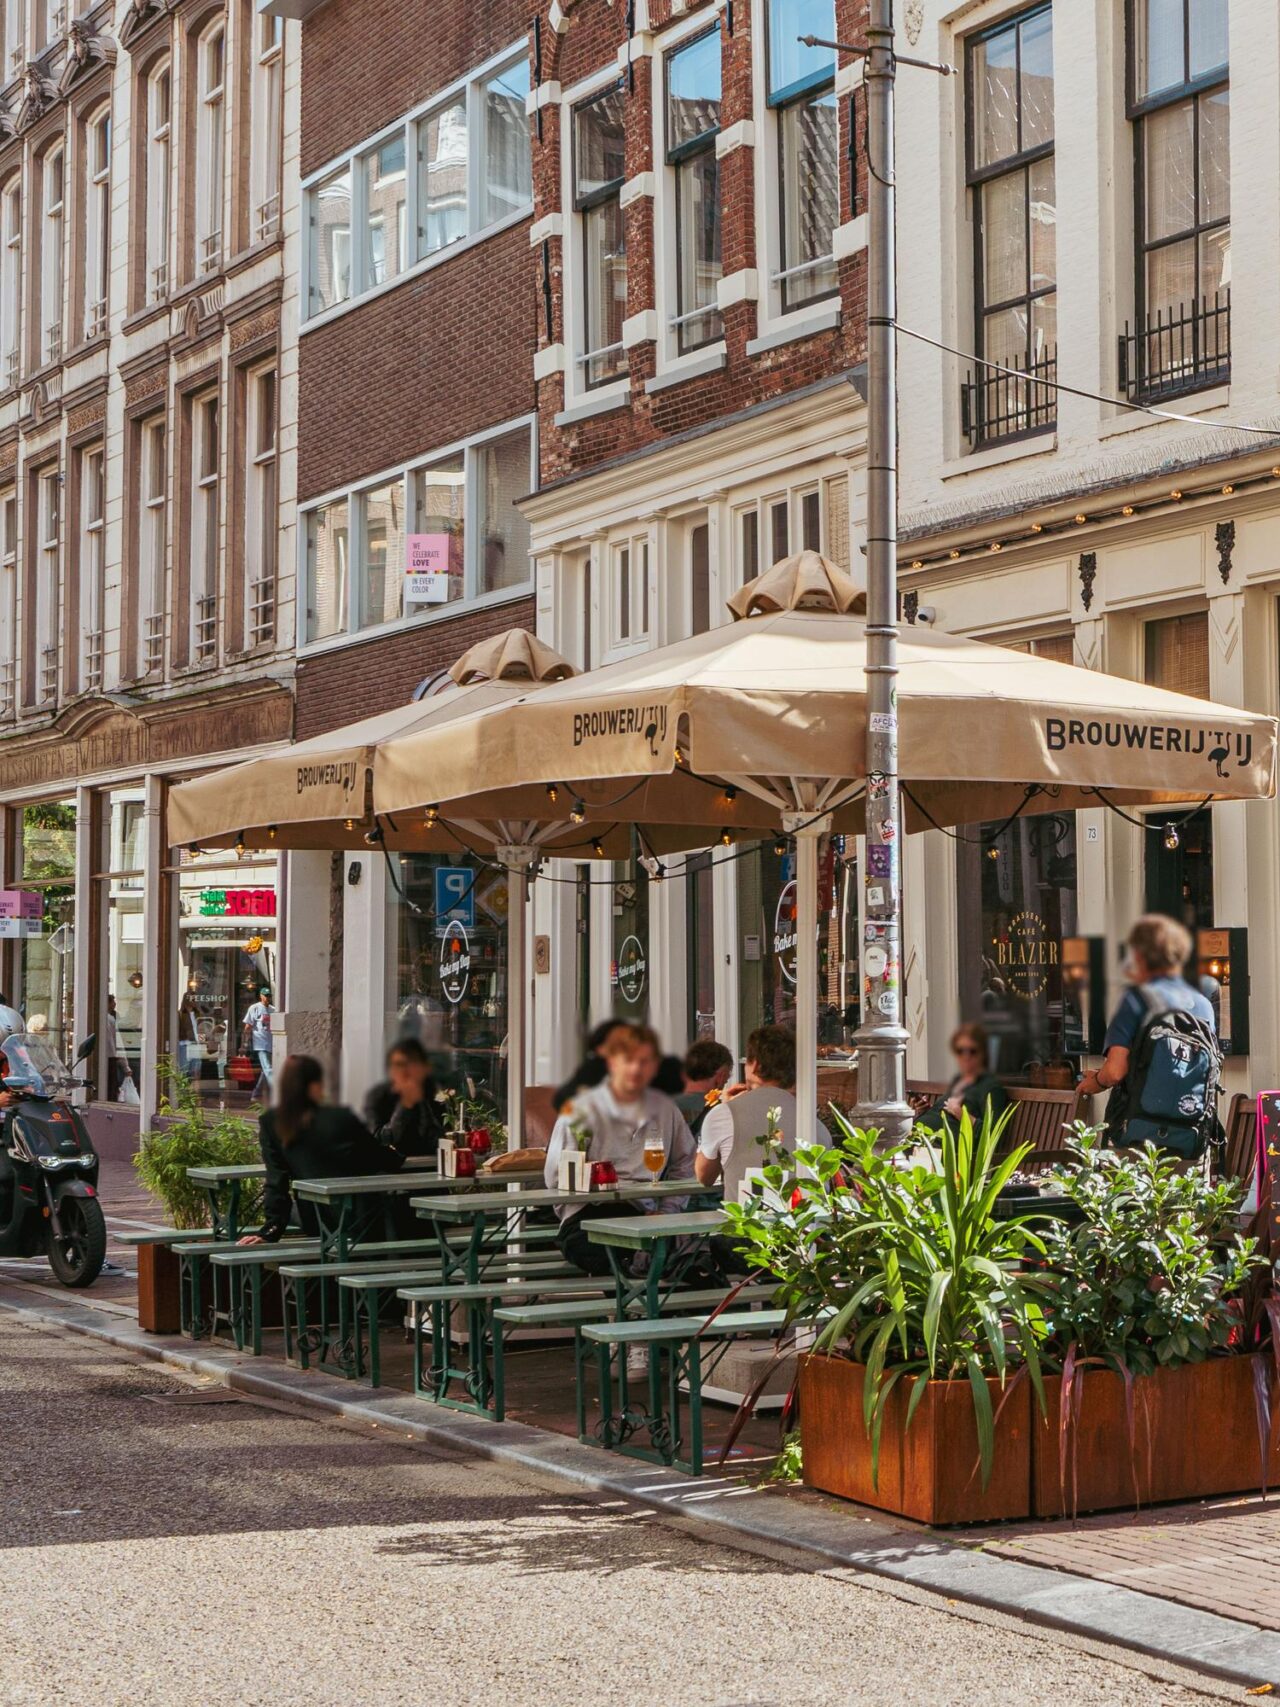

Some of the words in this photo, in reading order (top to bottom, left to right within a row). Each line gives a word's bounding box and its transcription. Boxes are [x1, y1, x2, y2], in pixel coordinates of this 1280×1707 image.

[412, 550, 440, 558] CELEBRATE
[574, 707, 645, 746] BROUWERIJ
[1046, 719, 1205, 754] BROUWERIJ
[1087, 828, 1097, 839] 73
[1008, 911, 1047, 932] BRASSERIE
[774, 934, 792, 953] Bake
[998, 941, 1058, 965] BLAZER
[186, 994, 228, 1002] FEESHO
